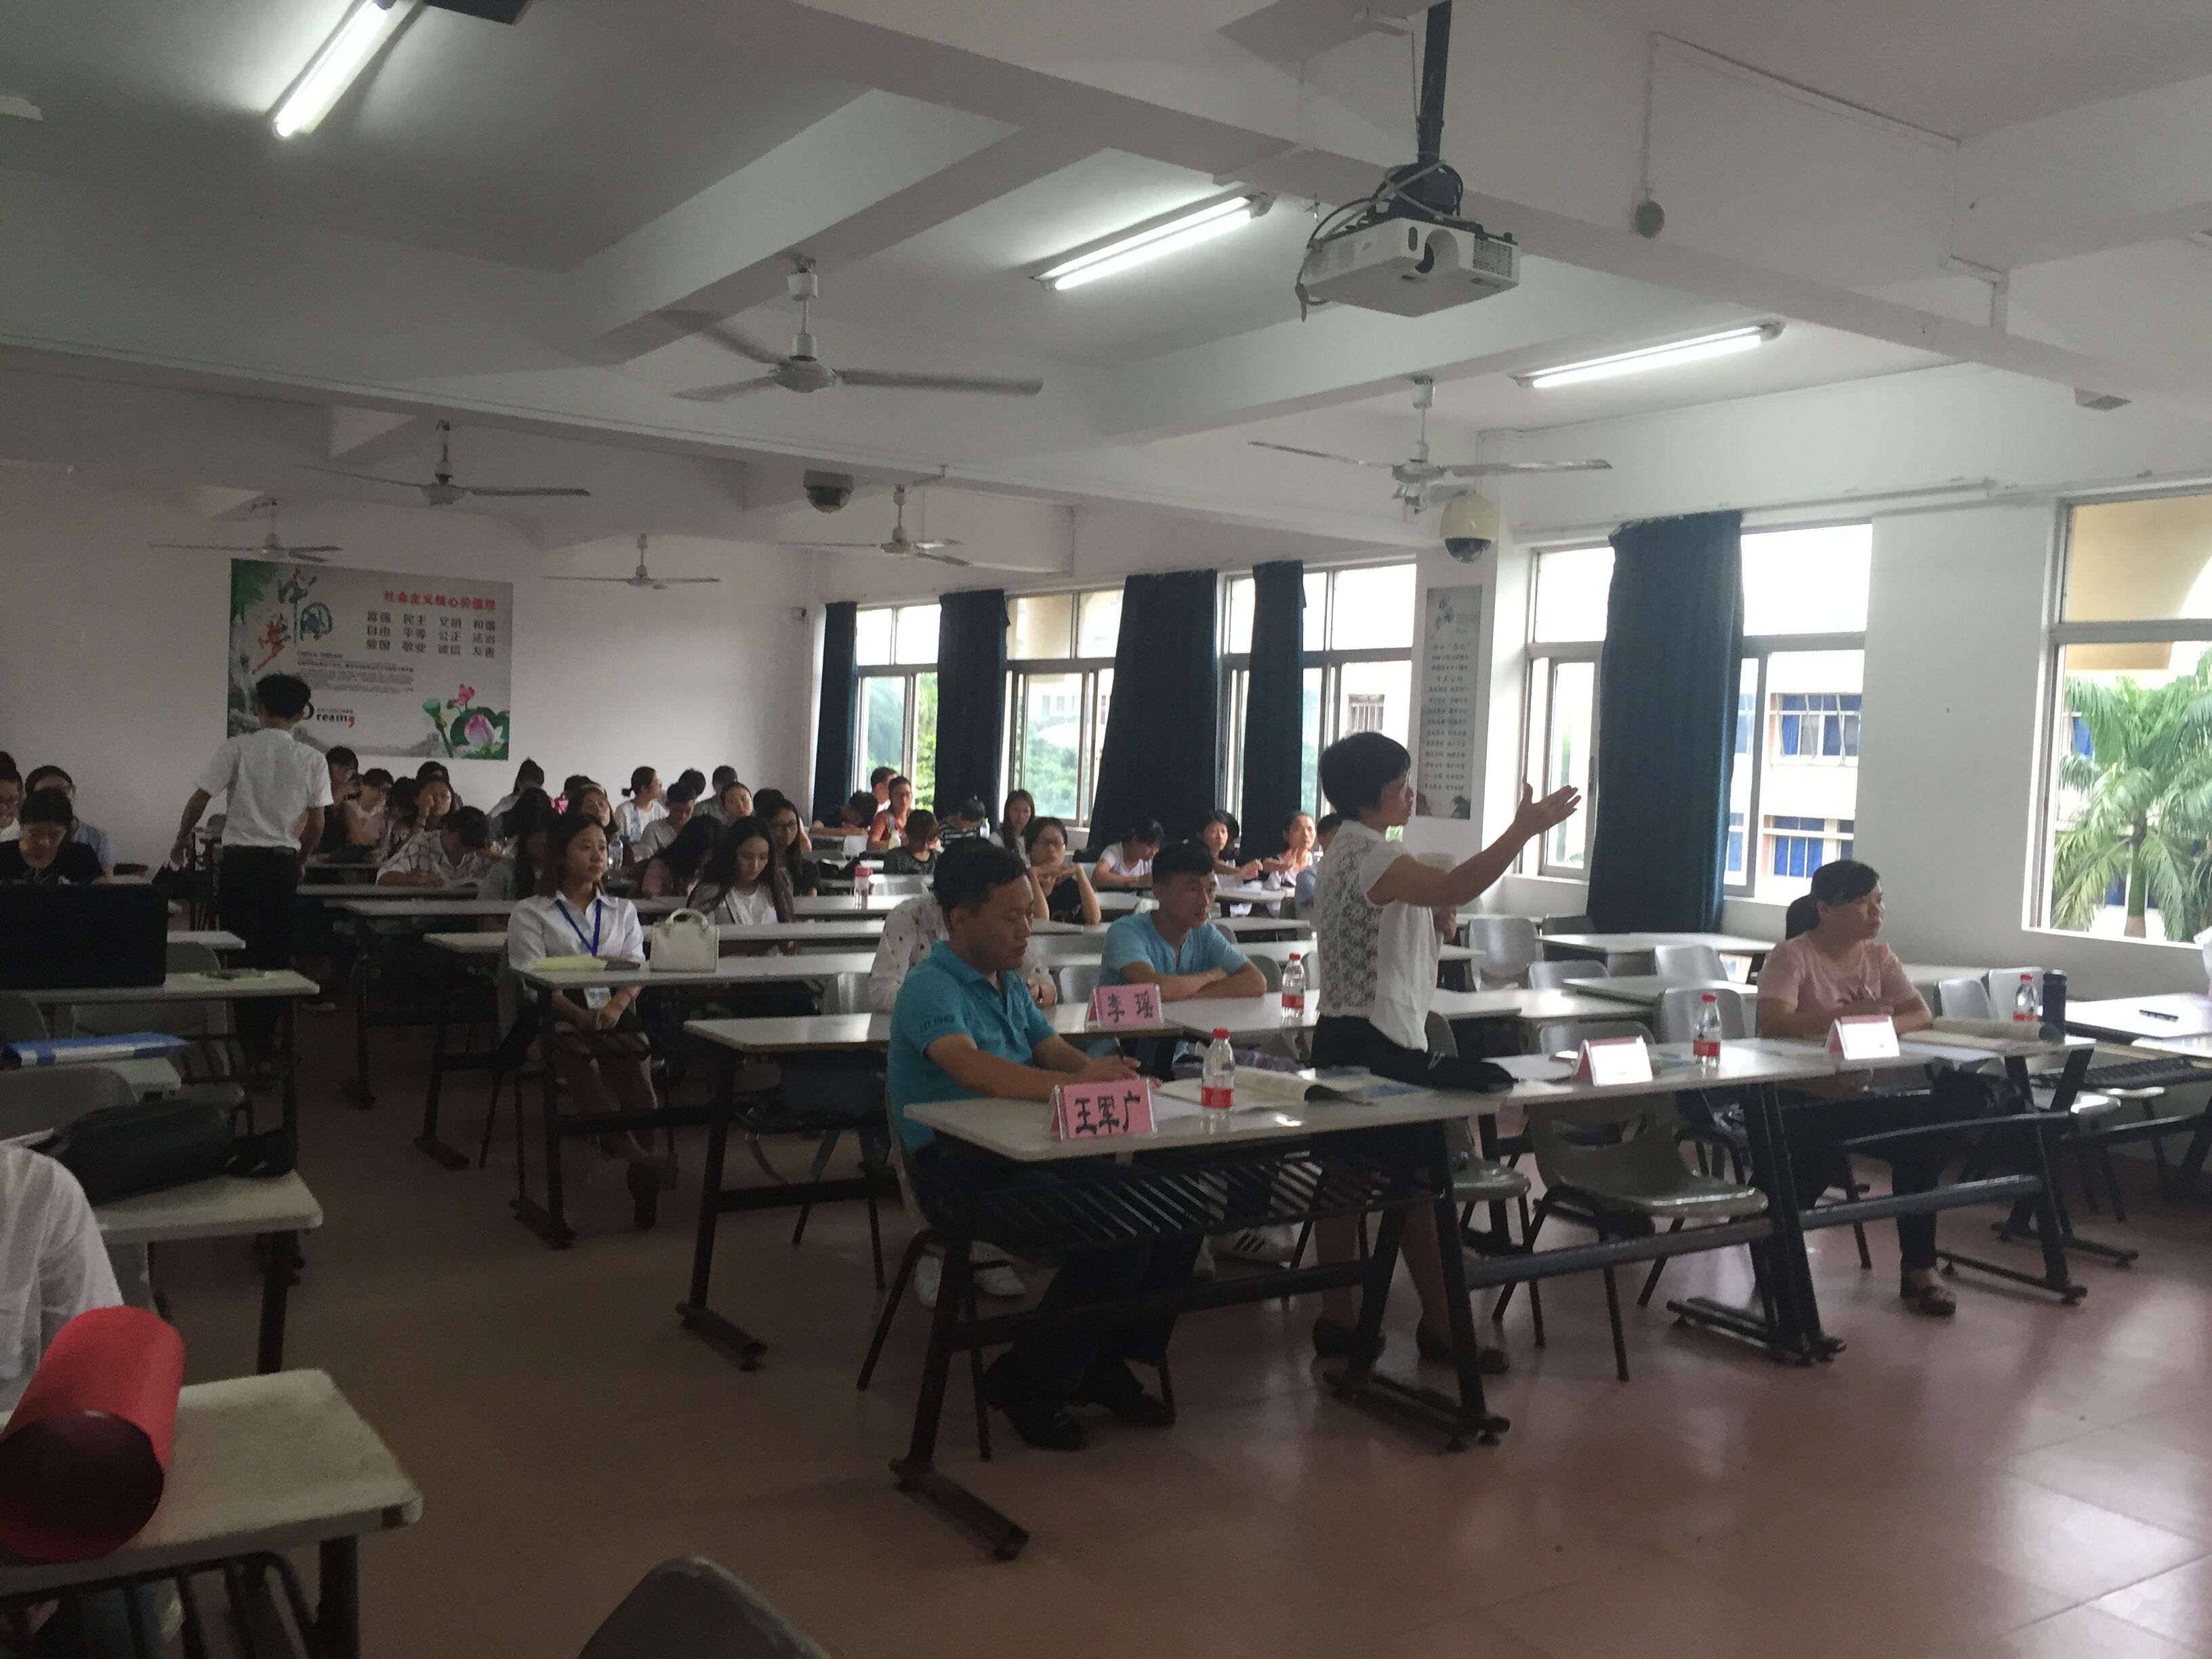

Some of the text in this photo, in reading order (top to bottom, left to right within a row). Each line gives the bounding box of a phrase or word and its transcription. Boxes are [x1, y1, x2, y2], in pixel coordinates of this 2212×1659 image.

[383, 590, 496, 610] 社会主义核心价值观
[1075, 1089, 1141, 1135] 王军广
